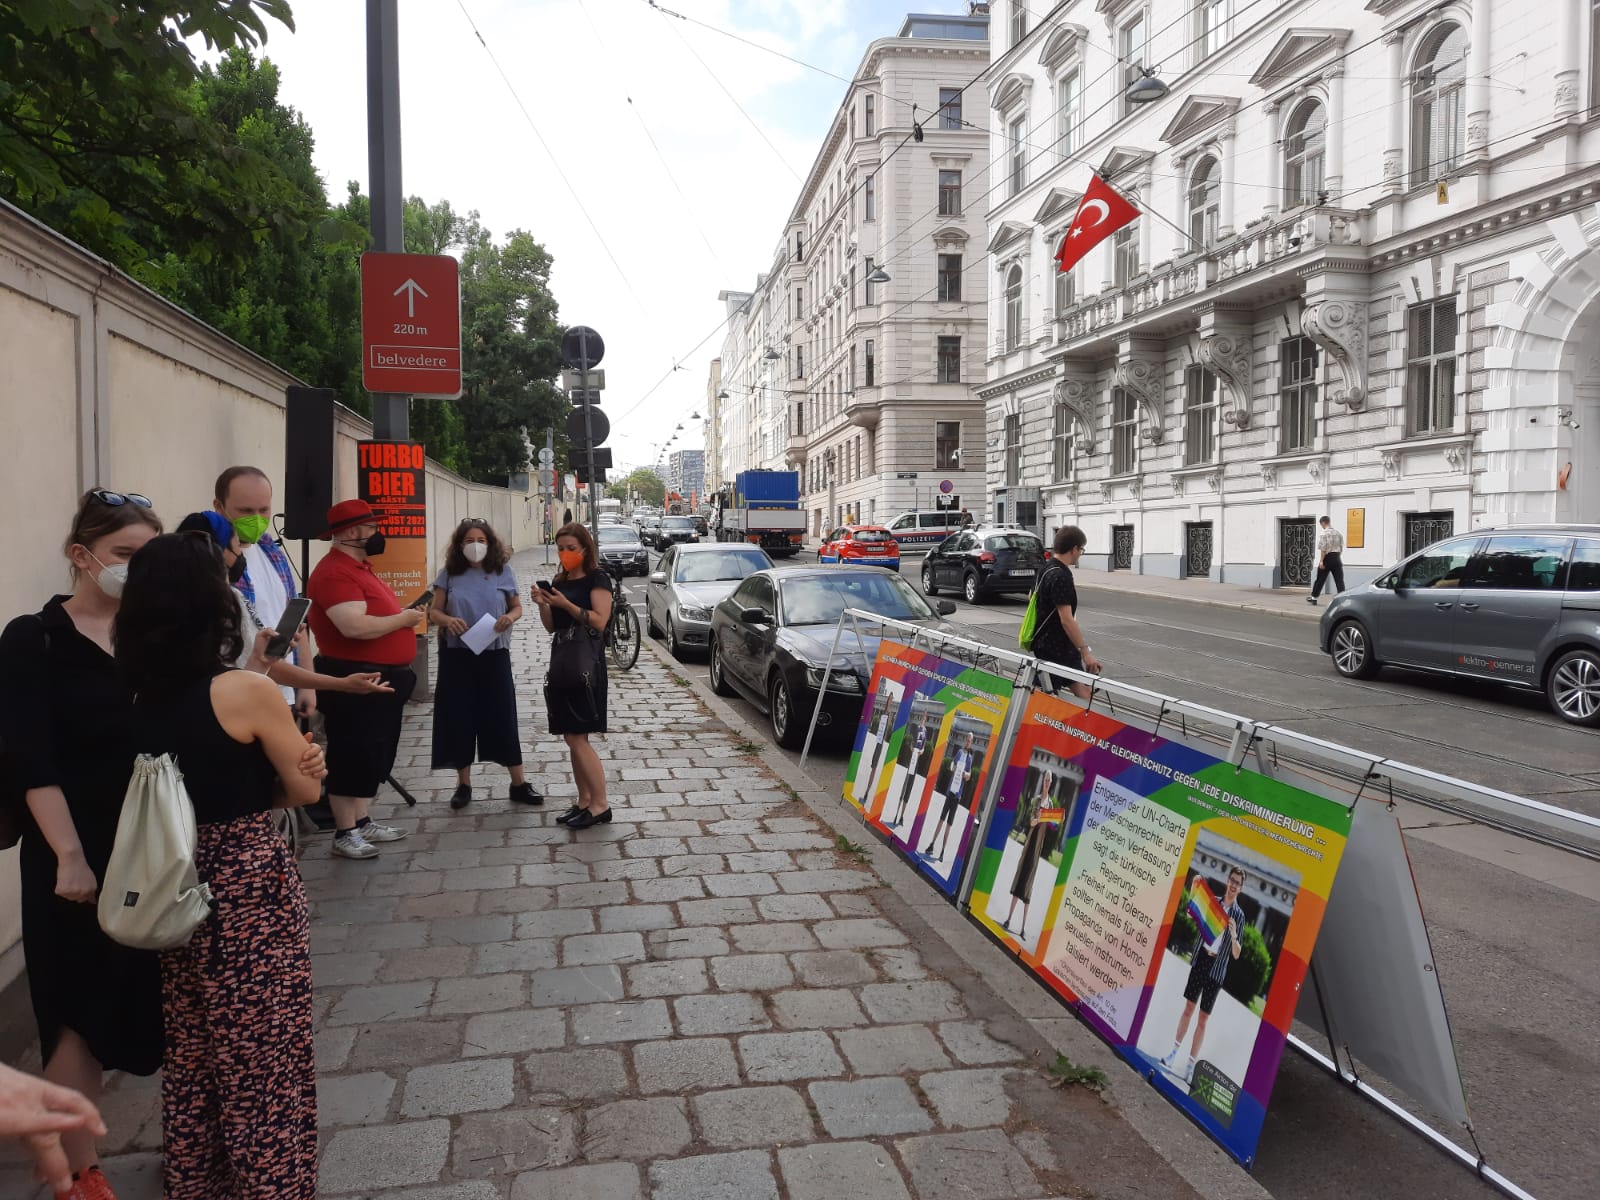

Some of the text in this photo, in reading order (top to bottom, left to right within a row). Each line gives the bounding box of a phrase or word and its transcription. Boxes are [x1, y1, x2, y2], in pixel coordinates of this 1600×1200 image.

[393, 324, 428, 335] 220 m
[377, 353, 447, 367] belvedere
[359, 443, 424, 470] TURBO
[369, 472, 415, 496] BIER
[388, 527, 410, 536] OPEN
[412, 527, 425, 536] AIR
[407, 516, 425, 525] 2021
[902, 535, 931, 543] POLIZEI
[393, 570, 421, 578] macht
[1034, 712, 1047, 725] ALLE
[1048, 718, 1066, 732] HABEN
[1065, 724, 1096, 745] ANSPRUCH
[1097, 739, 1110, 751] AUF
[1111, 744, 1143, 765] GLEICHEN
[1143, 757, 1172, 779] SCHUTZ
[1173, 770, 1201, 791] GEGEN
[1201, 782, 1220, 800] JEDE
[1221, 790, 1314, 840] DISKRIMINIERUNG
[1094, 782, 1186, 838] Entgegen der UN-Charta
[1086, 817, 1099, 830] der
[1100, 825, 1126, 845] eigenen
[1089, 800, 1181, 857] der Menschenrechte und
[1092, 840, 1157, 887] sagt die türkische
[1100, 862, 1138, 898] Regierung:
[1072, 886, 1148, 947] sollten niemals für die
[1105, 888, 1120, 905] und
[1121, 896, 1154, 929] Toleranz
[1064, 897, 1146, 967] Propaganda von Homo-
[1065, 920, 1134, 980] sexuellen instrumen-
[1066, 941, 1090, 969] talisiert
